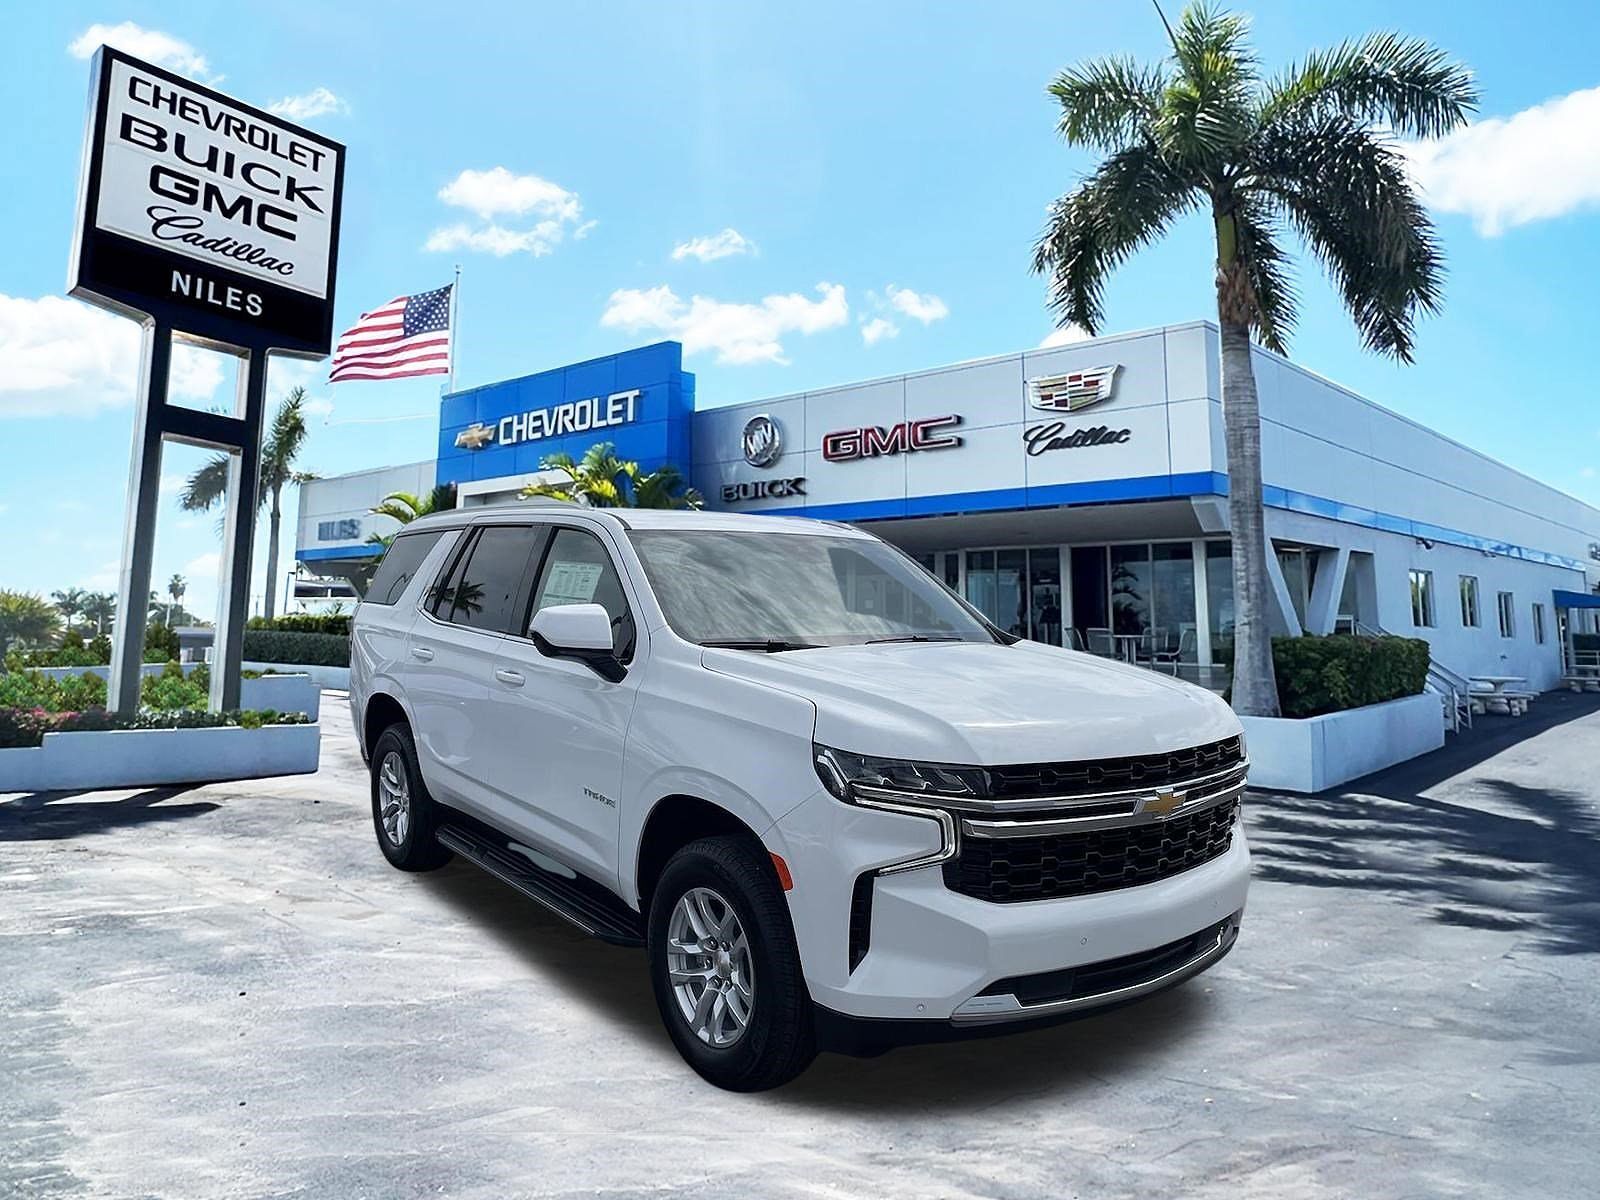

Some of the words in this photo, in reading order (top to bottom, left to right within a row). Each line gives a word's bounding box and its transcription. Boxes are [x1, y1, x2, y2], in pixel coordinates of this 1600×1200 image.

[128, 75, 326, 173] CHEVROLET
[119, 112, 325, 215] BUICK
[149, 164, 298, 242] GMC
[146, 205, 294, 276] Cadillac
[171, 270, 264, 317] NILES
[498, 389, 641, 446] CHEVROLET
[822, 414, 962, 463] GMC
[1022, 421, 1131, 457] Cadillac
[720, 477, 807, 502] BUICK
